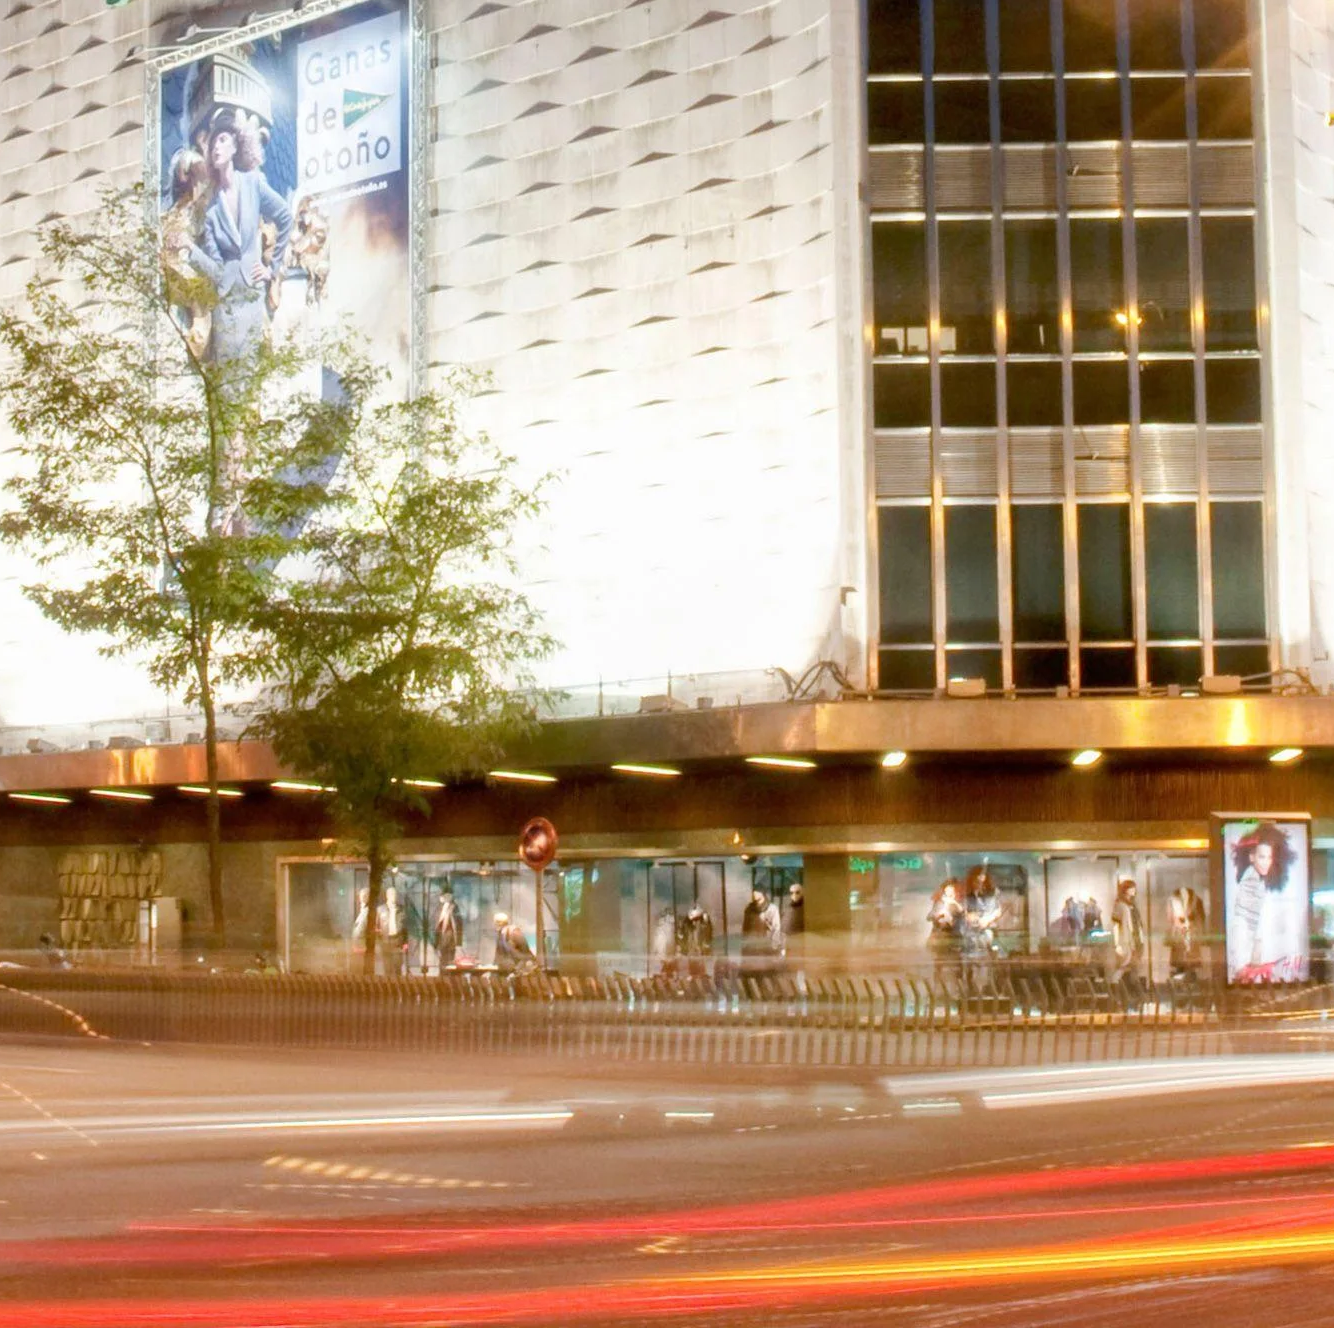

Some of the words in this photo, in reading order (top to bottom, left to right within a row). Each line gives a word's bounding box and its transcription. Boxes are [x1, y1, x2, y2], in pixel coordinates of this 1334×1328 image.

[305, 39, 392, 85] Ganas
[305, 99, 337, 135] de
[305, 129, 391, 180] otoño
